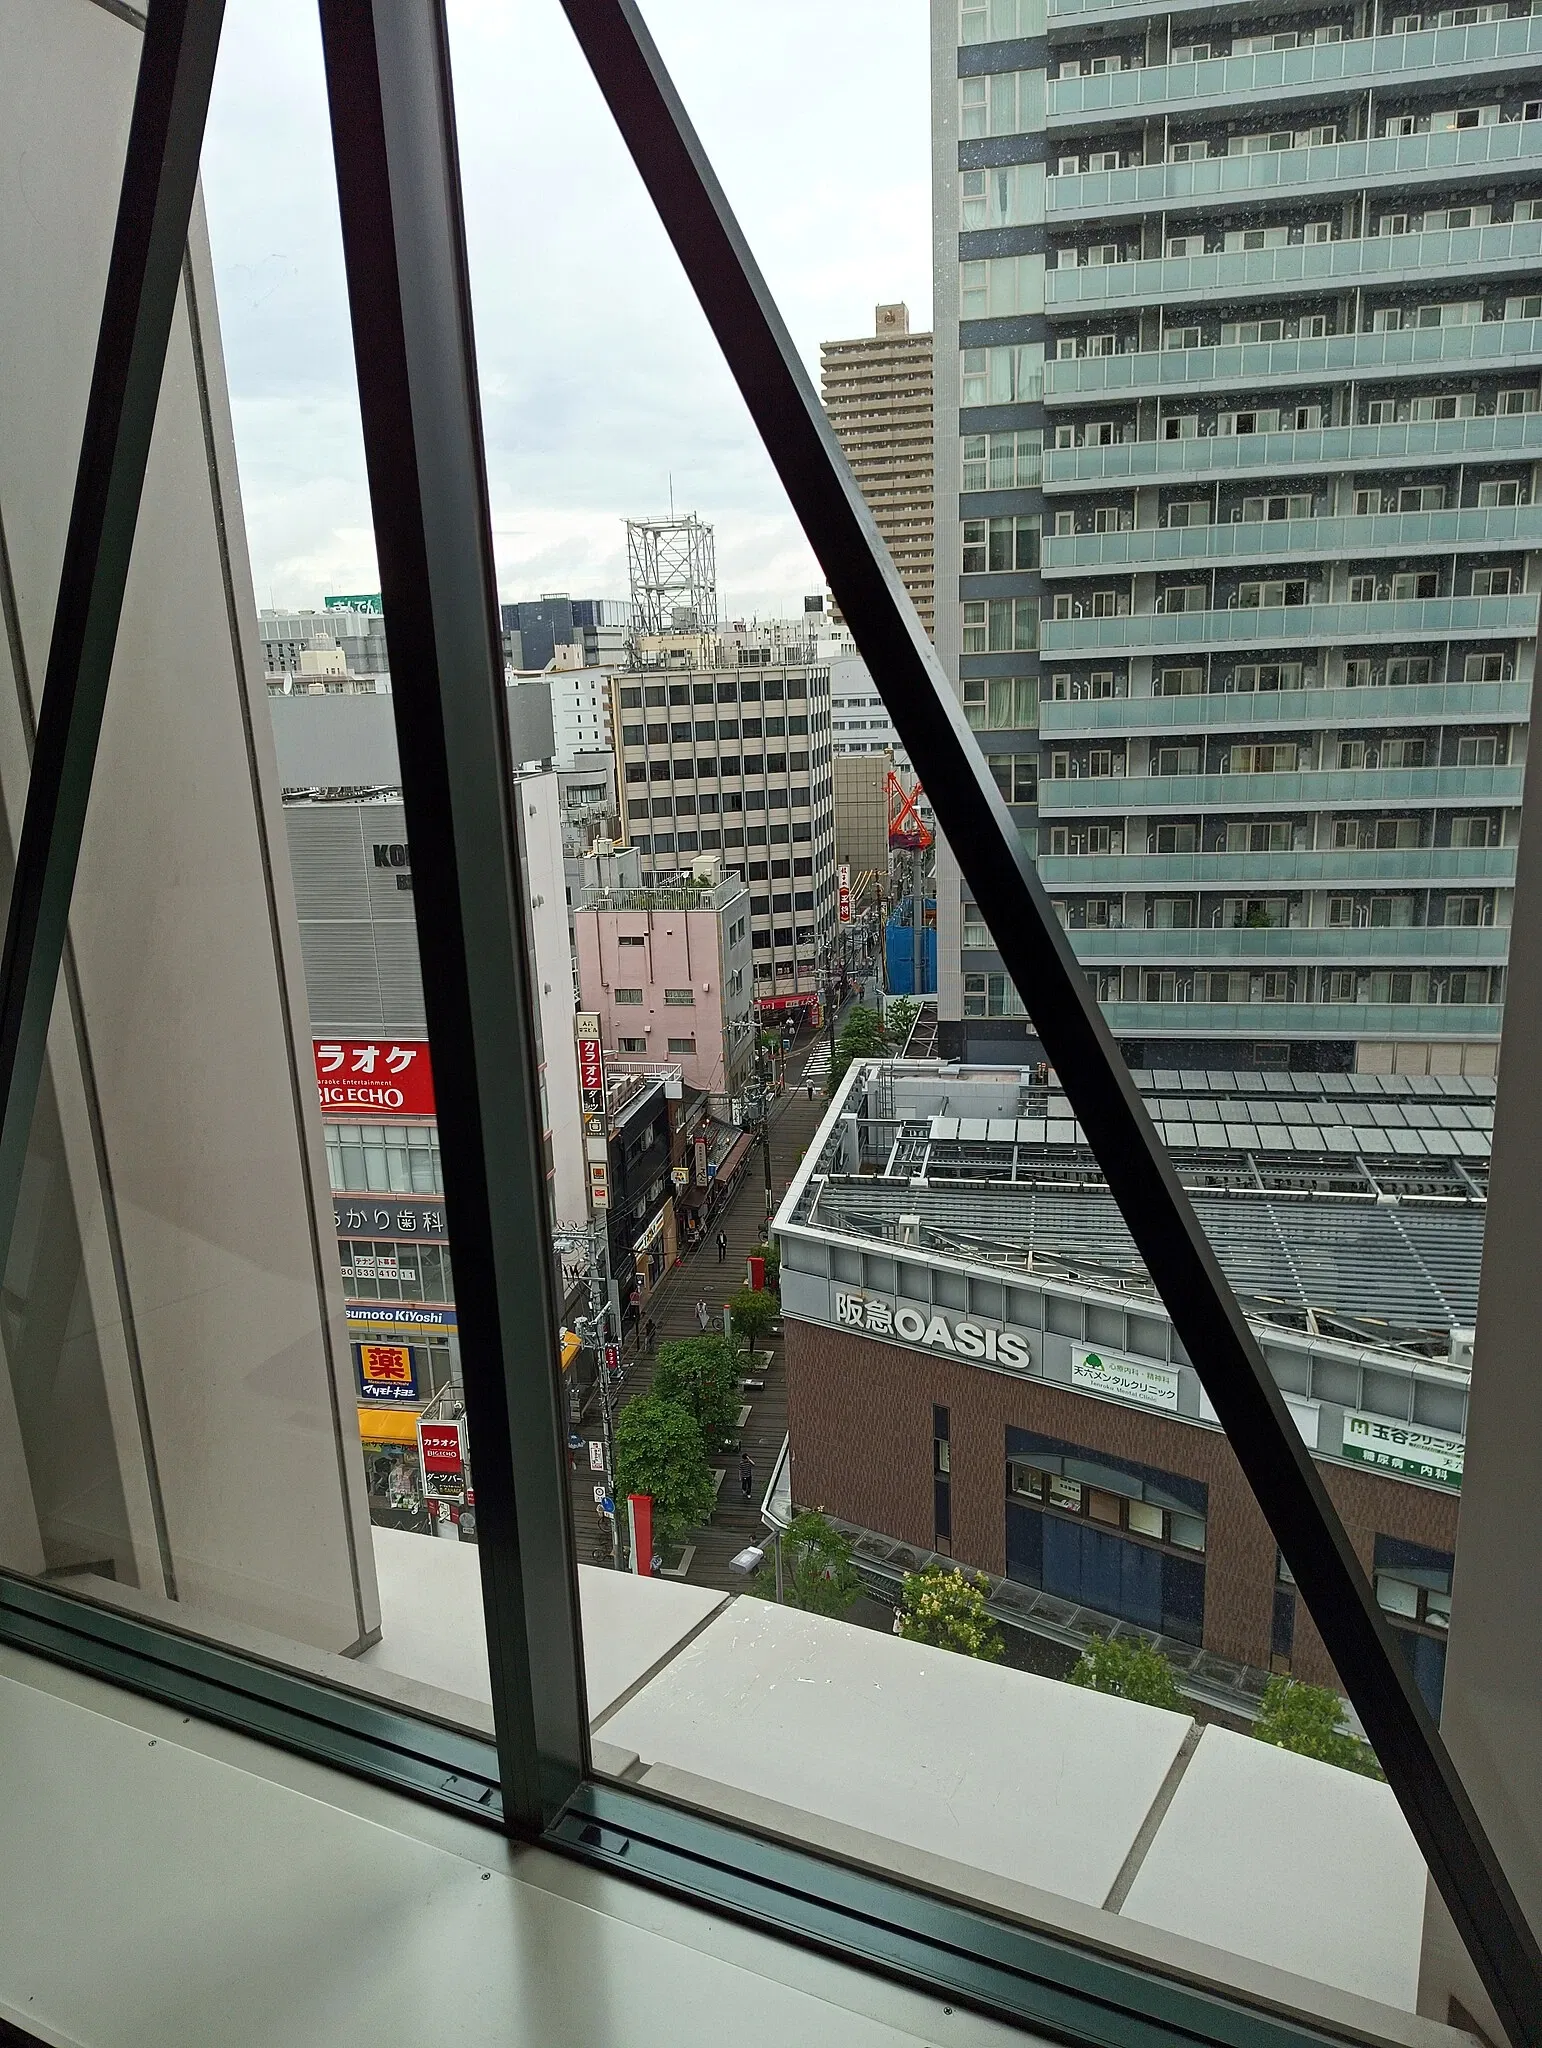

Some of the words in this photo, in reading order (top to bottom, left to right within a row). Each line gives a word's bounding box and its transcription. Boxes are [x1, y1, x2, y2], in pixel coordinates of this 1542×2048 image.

[317, 1045, 417, 1074] ラオケ
[584, 1041, 598, 1086] カラオケ
[347, 1088, 404, 1108] ECHO
[395, 1310, 442, 1323] KiYoshi
[367, 1347, 405, 1379] 薬
[363, 1385, 415, 1398] マツモトキヨシ
[1074, 1365, 1176, 1399] 天六メンタルクリニック
[424, 1438, 457, 1447] カラオケ
[1372, 1423, 1465, 1453] 玉谷クリニック
